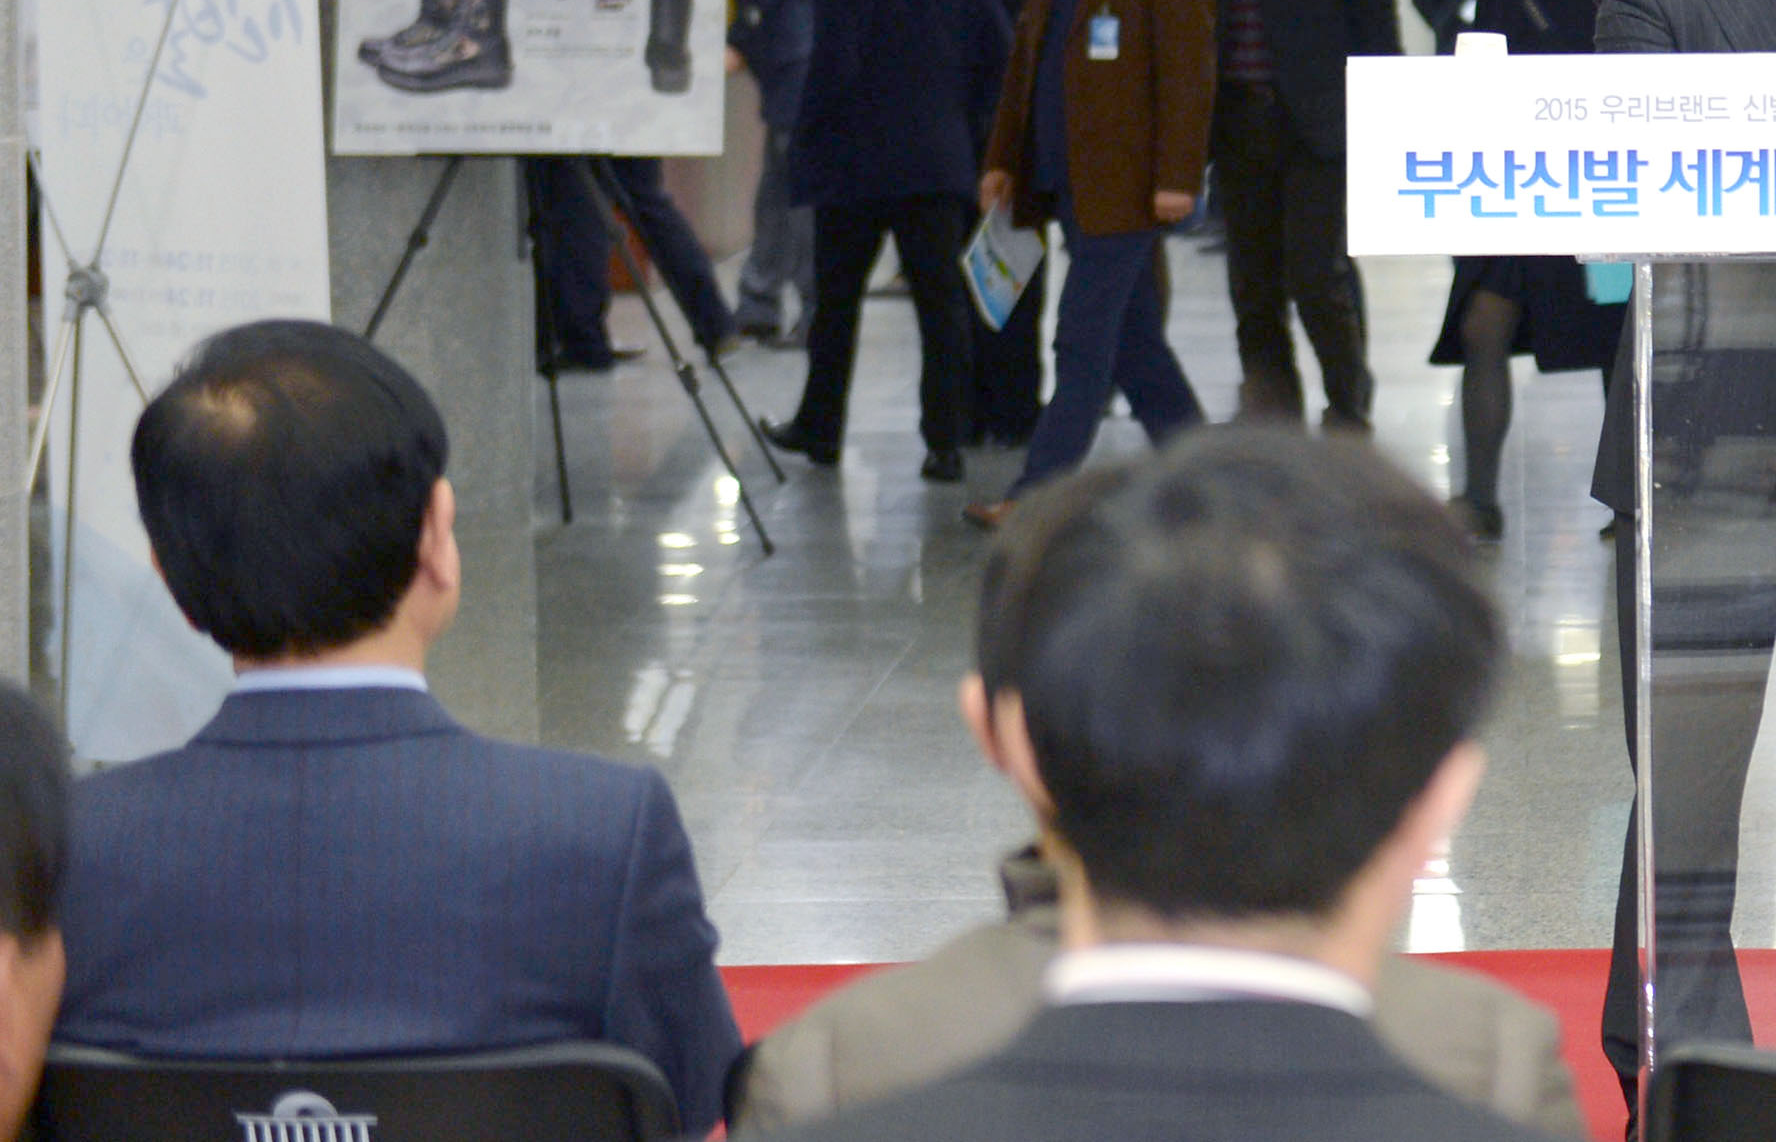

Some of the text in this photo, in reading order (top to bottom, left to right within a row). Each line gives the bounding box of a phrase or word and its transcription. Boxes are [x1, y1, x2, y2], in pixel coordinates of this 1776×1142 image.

[1534, 97, 1588, 122] 2015
[1600, 94, 1731, 124] 우리브랜드
[1397, 149, 1650, 219] 부산신발
